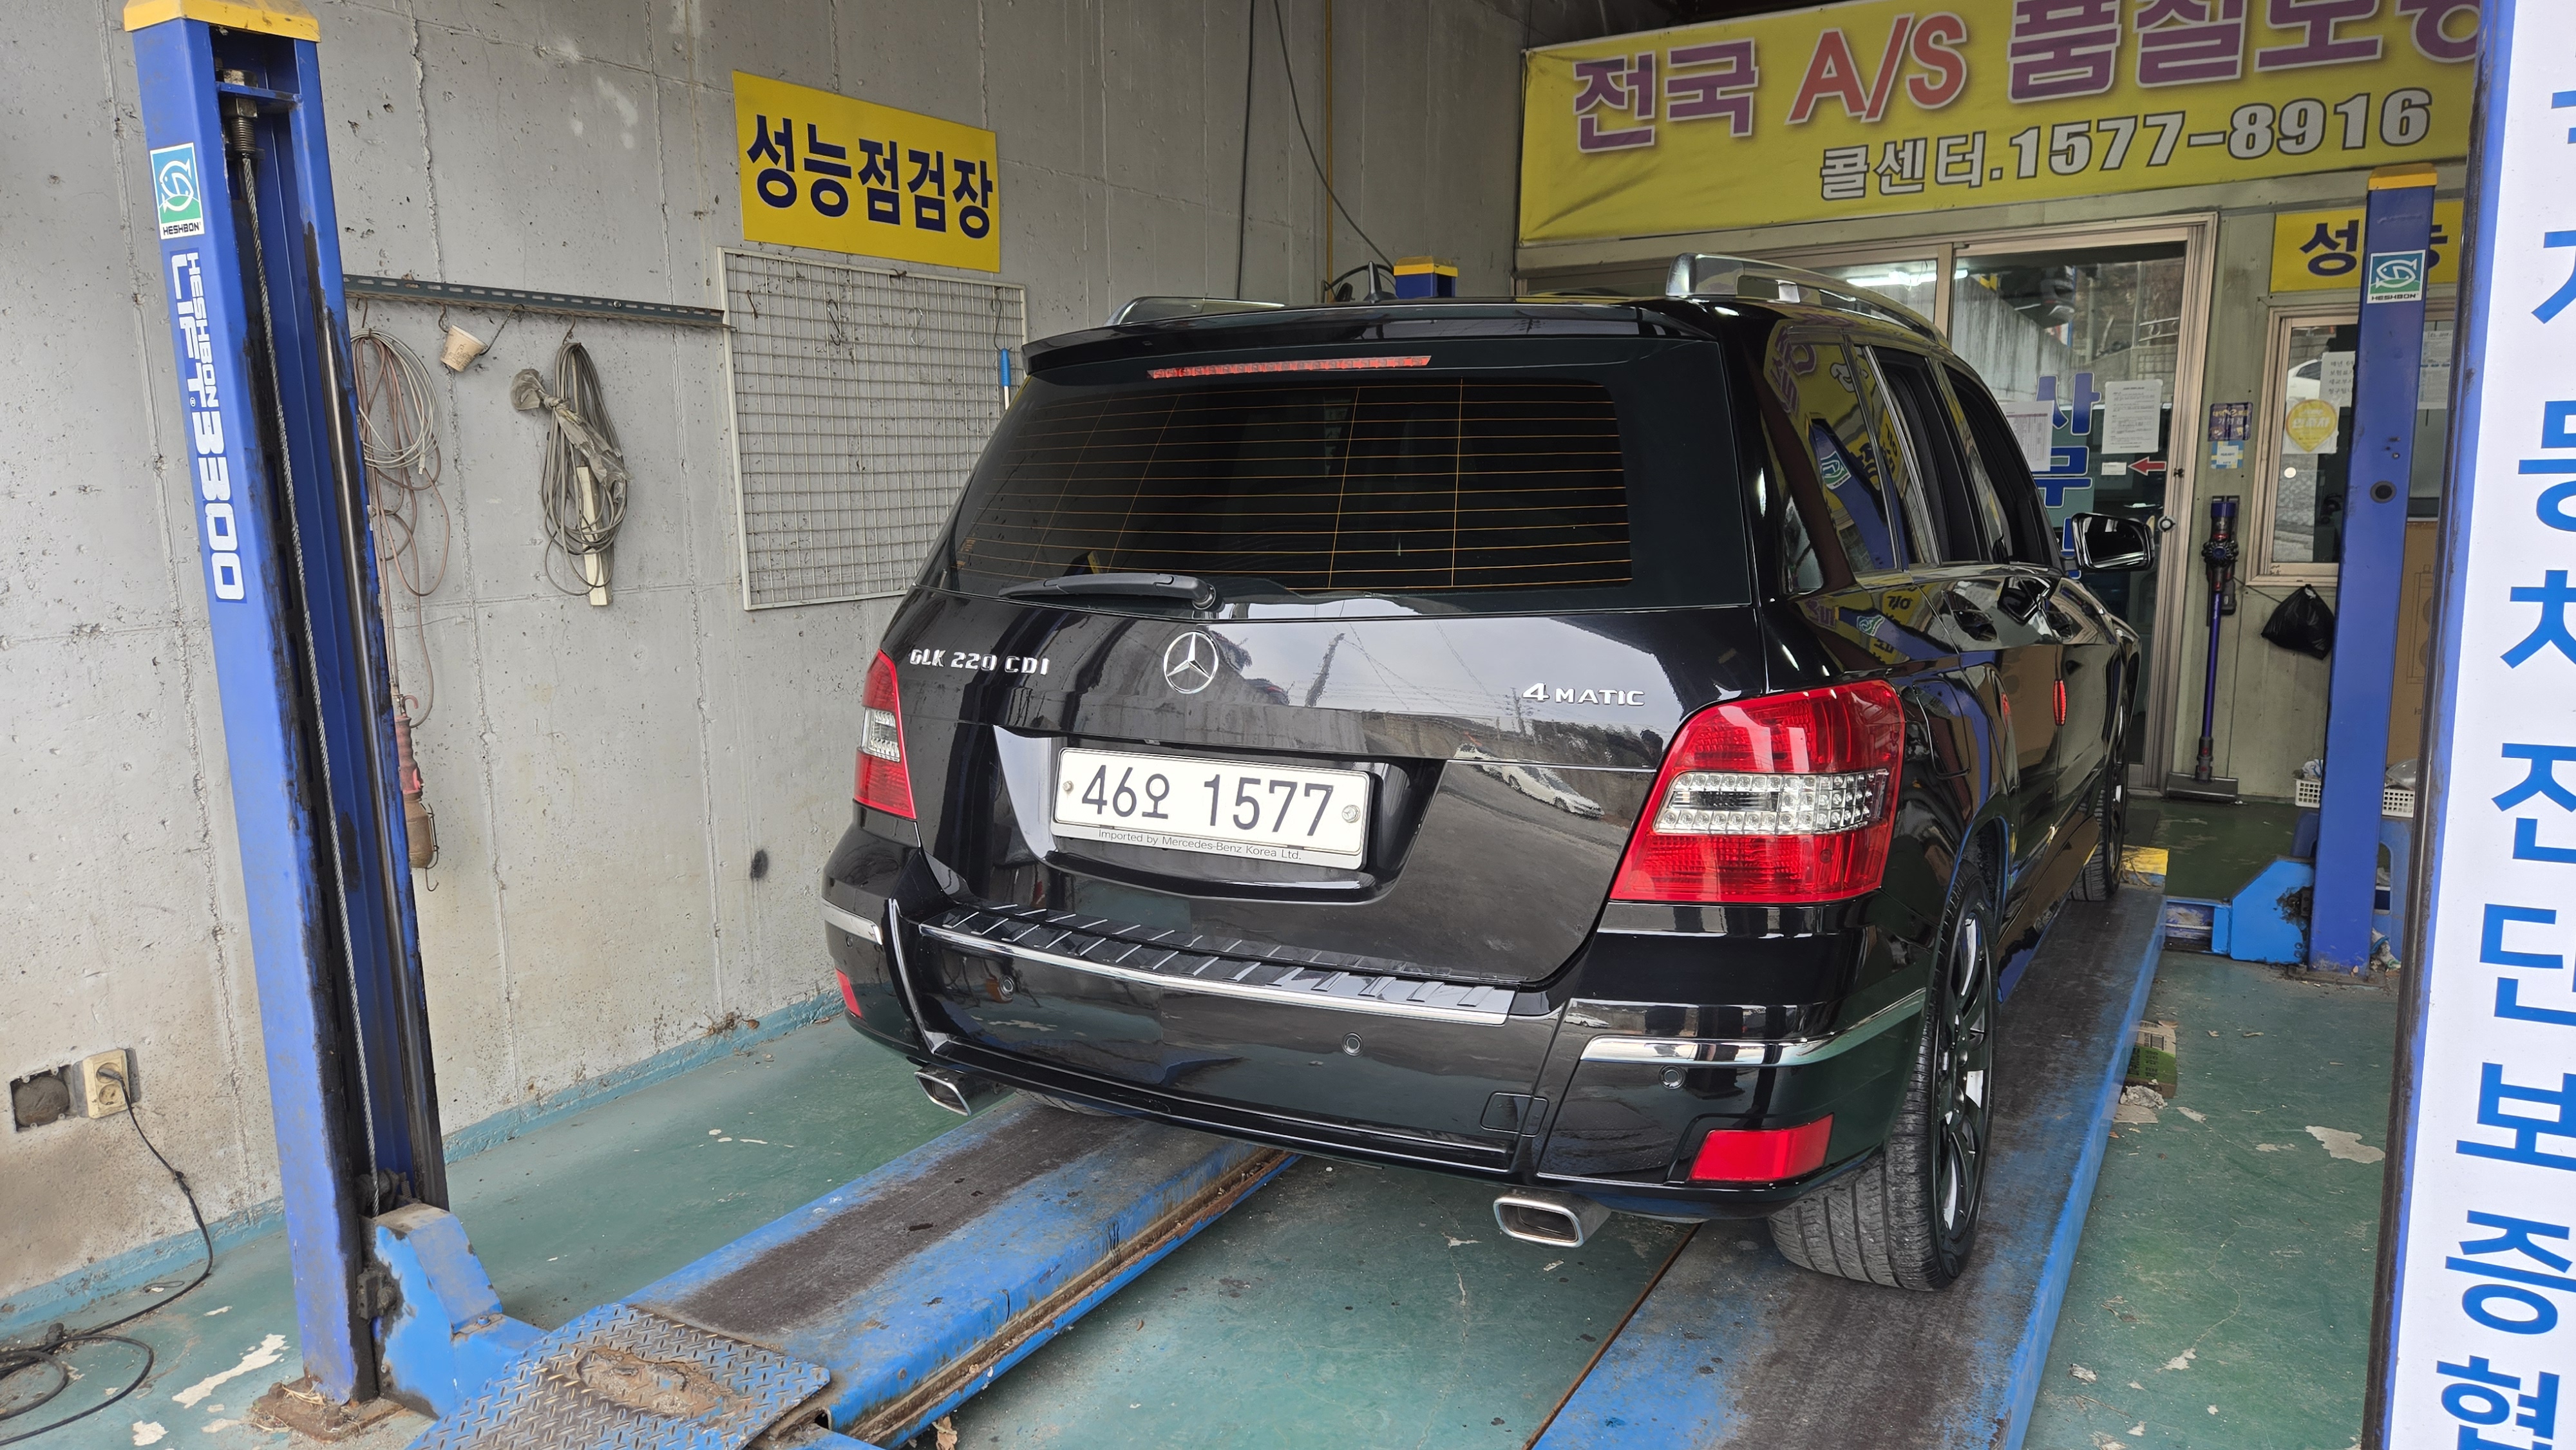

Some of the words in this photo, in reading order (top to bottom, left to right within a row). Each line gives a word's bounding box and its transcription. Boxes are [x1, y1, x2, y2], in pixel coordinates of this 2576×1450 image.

[1573, 37, 1759, 153] 전국
[1785, 12, 1968, 125] A/S
[746, 113, 994, 240] 성능점검장
[163, 221, 200, 236] HESHBON
[187, 252, 219, 408] HESHBON
[193, 410, 245, 601] 3300
[909, 648, 946, 668] GLK
[951, 652, 998, 671] 220
[1004, 655, 1050, 675] CDI
[1081, 764, 1170, 820] 46오
[1204, 774, 1334, 836] 1577
[1099, 829, 1143, 842] Imported
[1146, 835, 1159, 846] by
[1162, 836, 1242, 854] Mercedes-Benz
[1245, 845, 1277, 858] Korea
[1281, 849, 1302, 860] Ltd.
